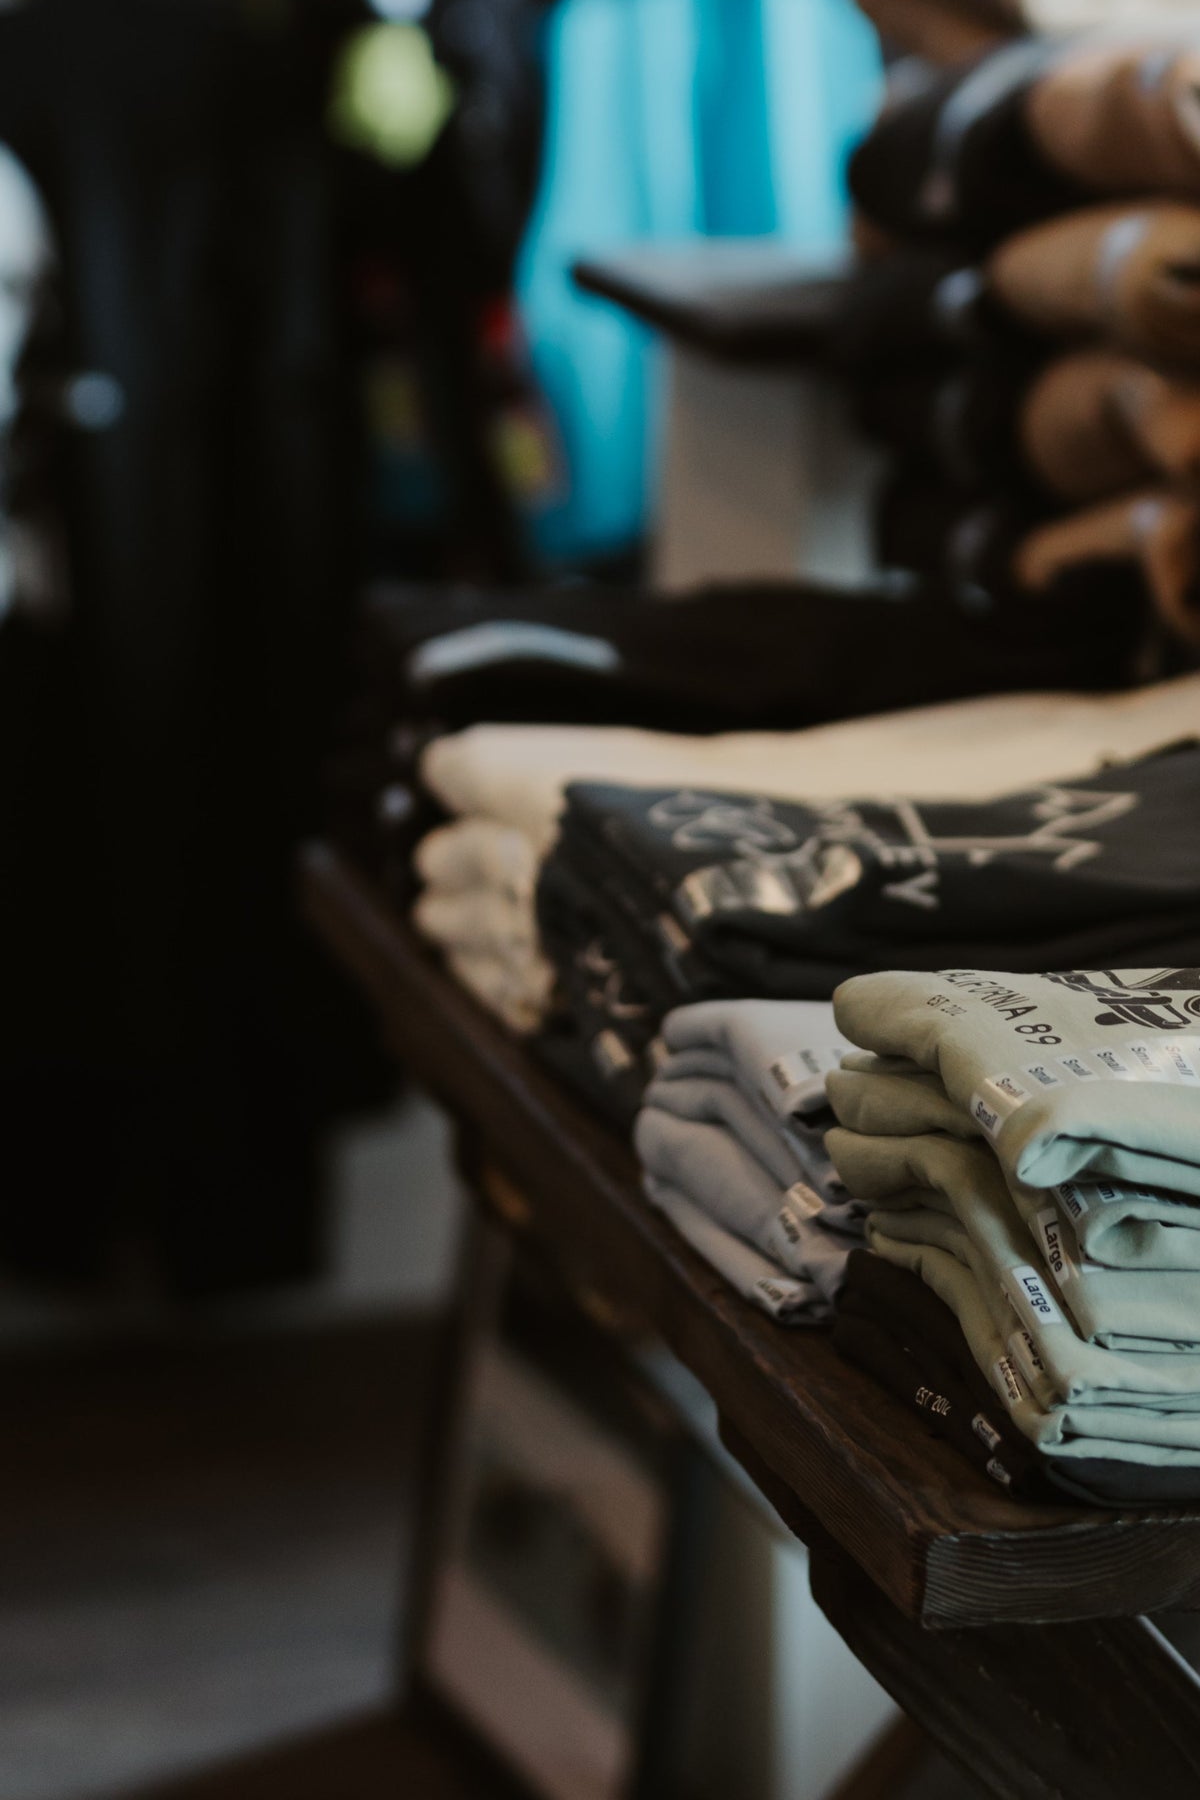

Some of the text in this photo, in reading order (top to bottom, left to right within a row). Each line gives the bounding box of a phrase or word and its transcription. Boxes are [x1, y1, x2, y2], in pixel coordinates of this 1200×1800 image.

[935, 969, 1062, 1045] ALIFORNIA 89
[1062, 1058, 1093, 1076] Small
[1097, 1051, 1127, 1072] Small
[1131, 1046, 1161, 1073] Small
[1166, 1045, 1194, 1077] Small
[996, 1077, 1025, 1098] Small
[1028, 1066, 1058, 1085] Small
[975, 1101, 998, 1130] Small
[1058, 1181, 1082, 1218] dium
[1044, 1221, 1063, 1273] Large
[1022, 1276, 1051, 1313] Large
[915, 1386, 934, 1408] EST
